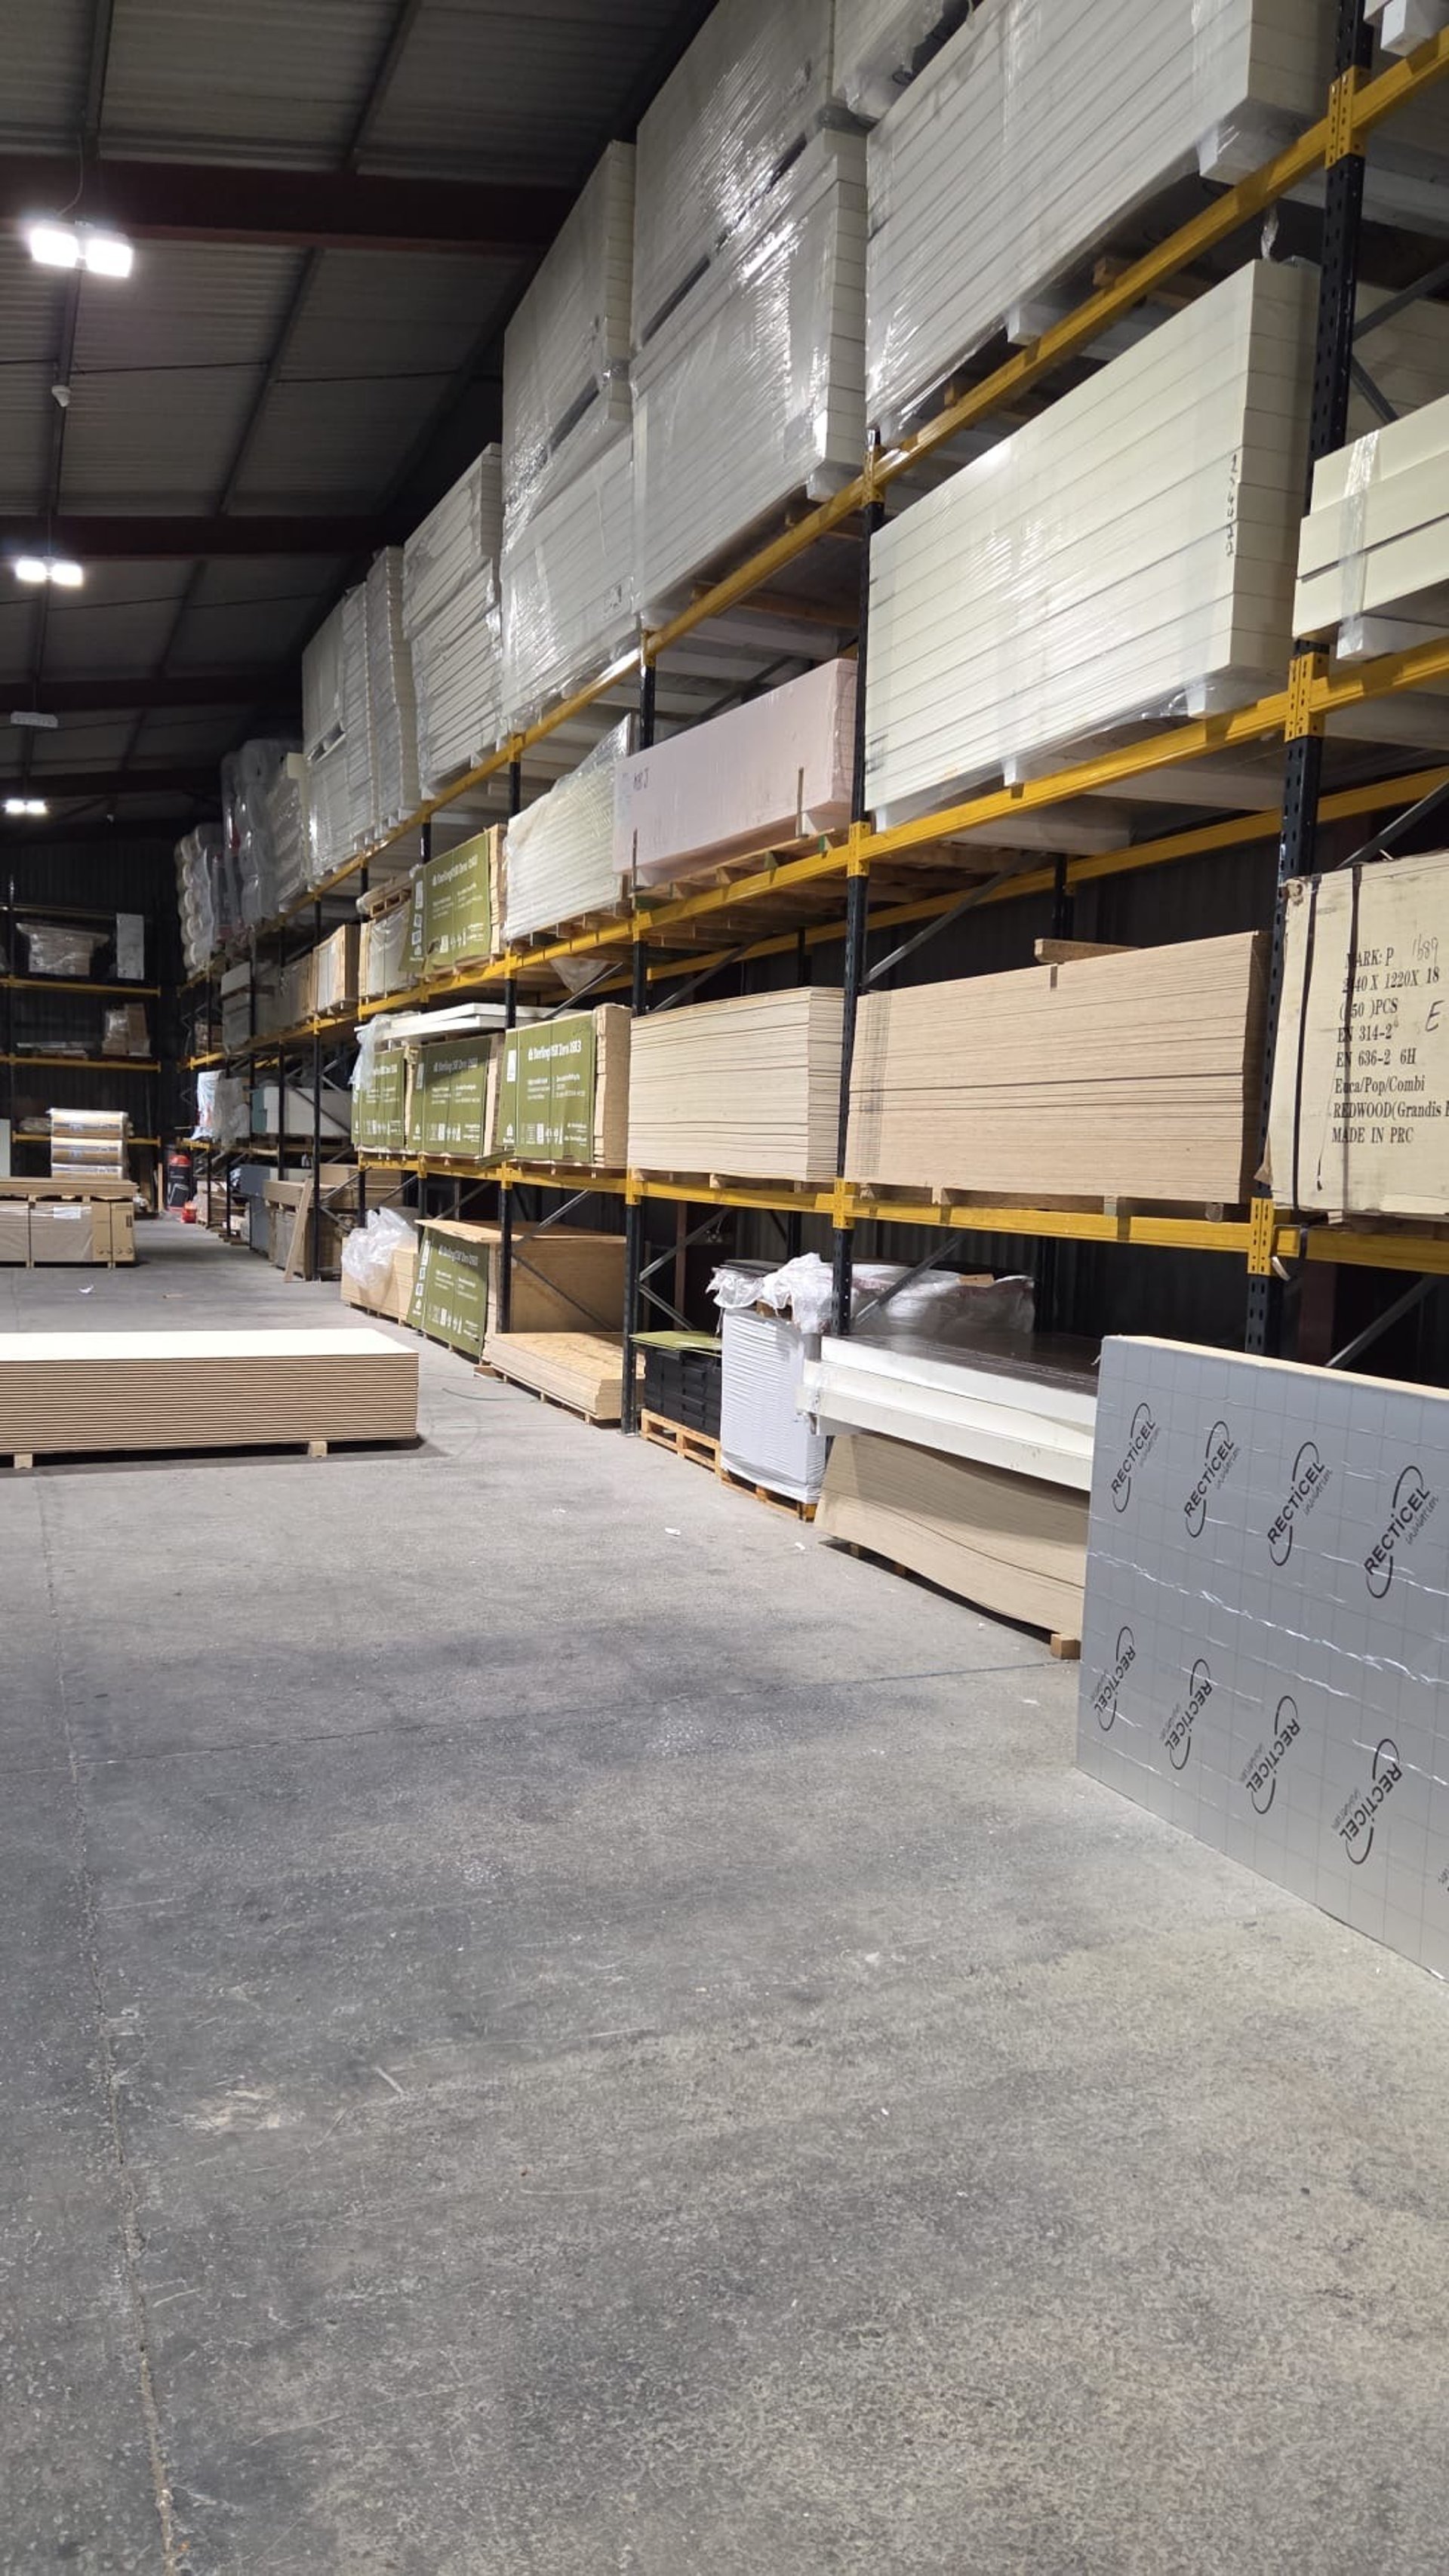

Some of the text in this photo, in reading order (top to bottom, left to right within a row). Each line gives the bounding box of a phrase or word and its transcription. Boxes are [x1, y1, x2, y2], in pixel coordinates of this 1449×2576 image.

[1345, 947, 1395, 968] ARK: P
[1426, 967, 1440, 984] 18
[1337, 1023, 1392, 1043] EN 314-2
[1358, 1048, 1391, 1067] 636-2
[1332, 1126, 1414, 1143] MADE IN PRC
